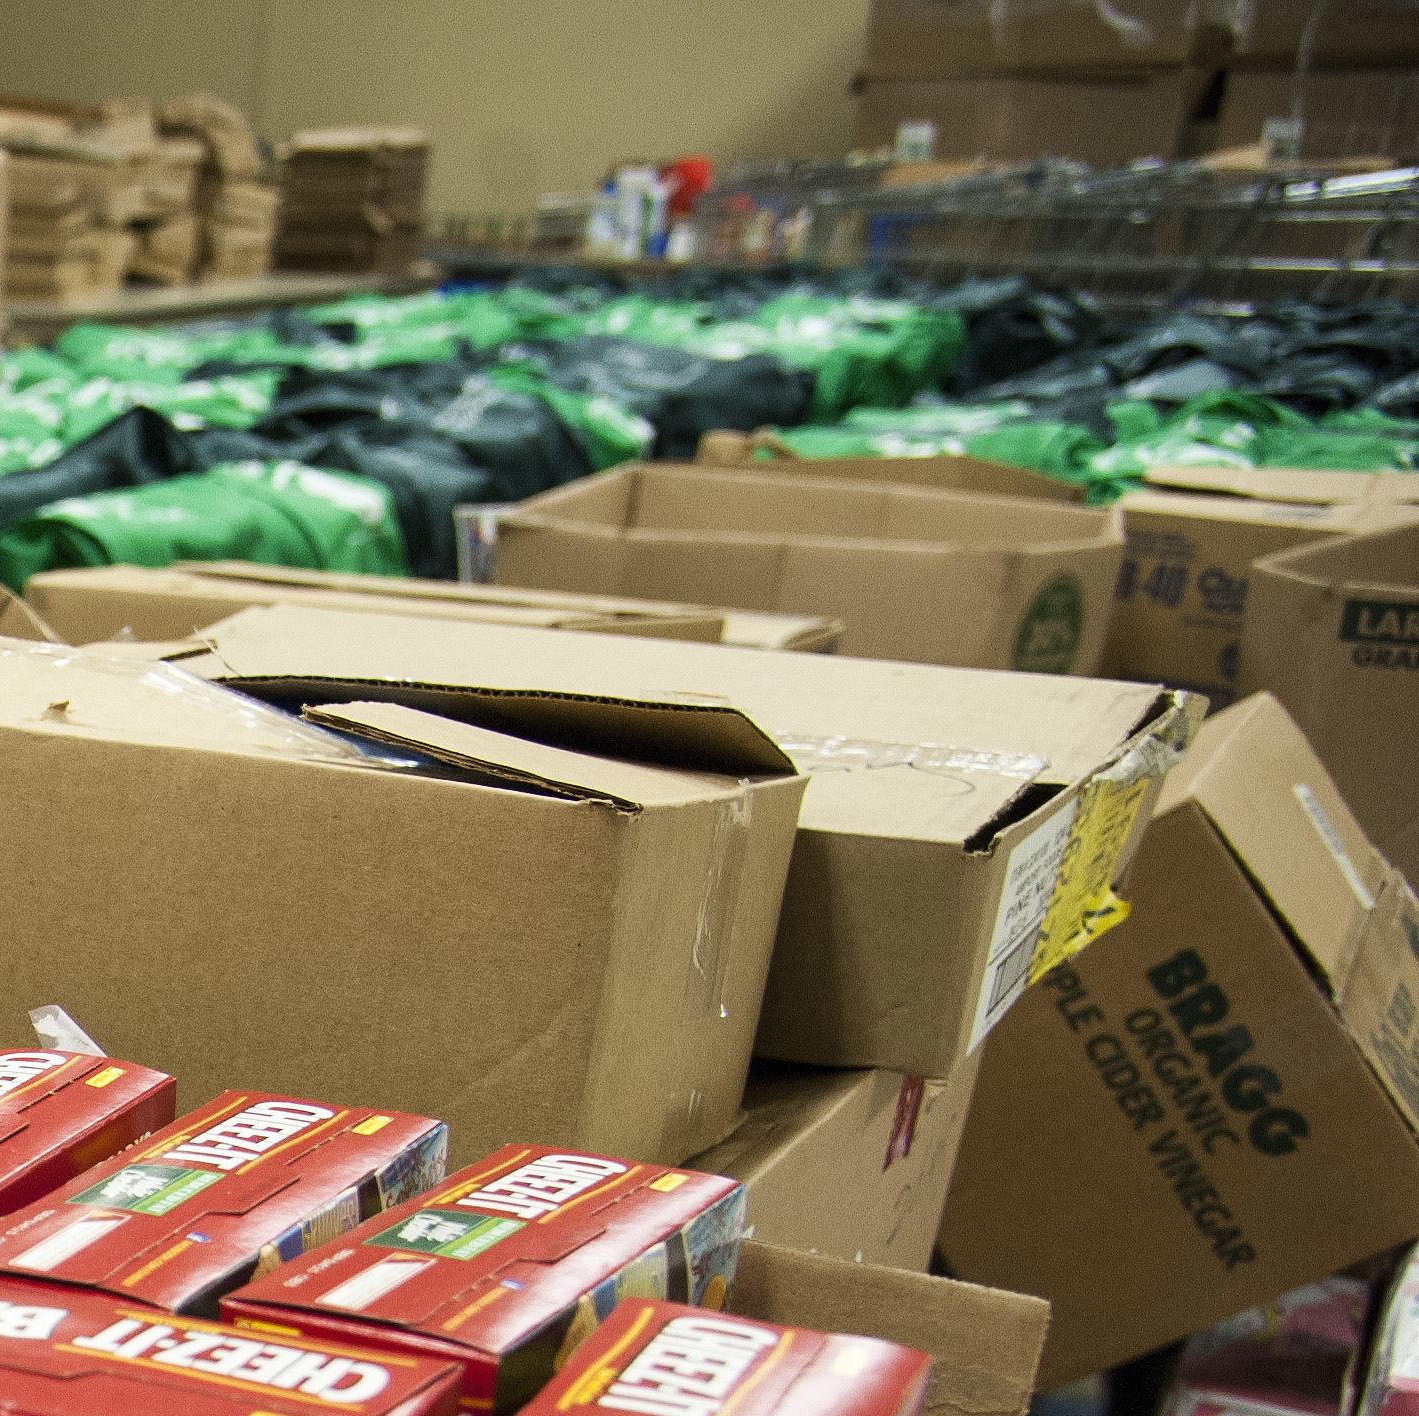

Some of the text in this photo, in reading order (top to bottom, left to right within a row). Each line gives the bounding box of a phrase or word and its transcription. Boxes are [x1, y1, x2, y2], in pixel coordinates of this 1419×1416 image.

[1125, 1009, 1240, 1153] ORGANIC
[1148, 948, 1310, 1157] BRAGG
[161, 1101, 336, 1170] CHEEZ-IT
[1042, 960, 1257, 1272] PLE CIDER VINEGAR
[458, 1154, 628, 1219] CHEEZ-IT
[76, 1318, 392, 1404] CHEEZ-IT
